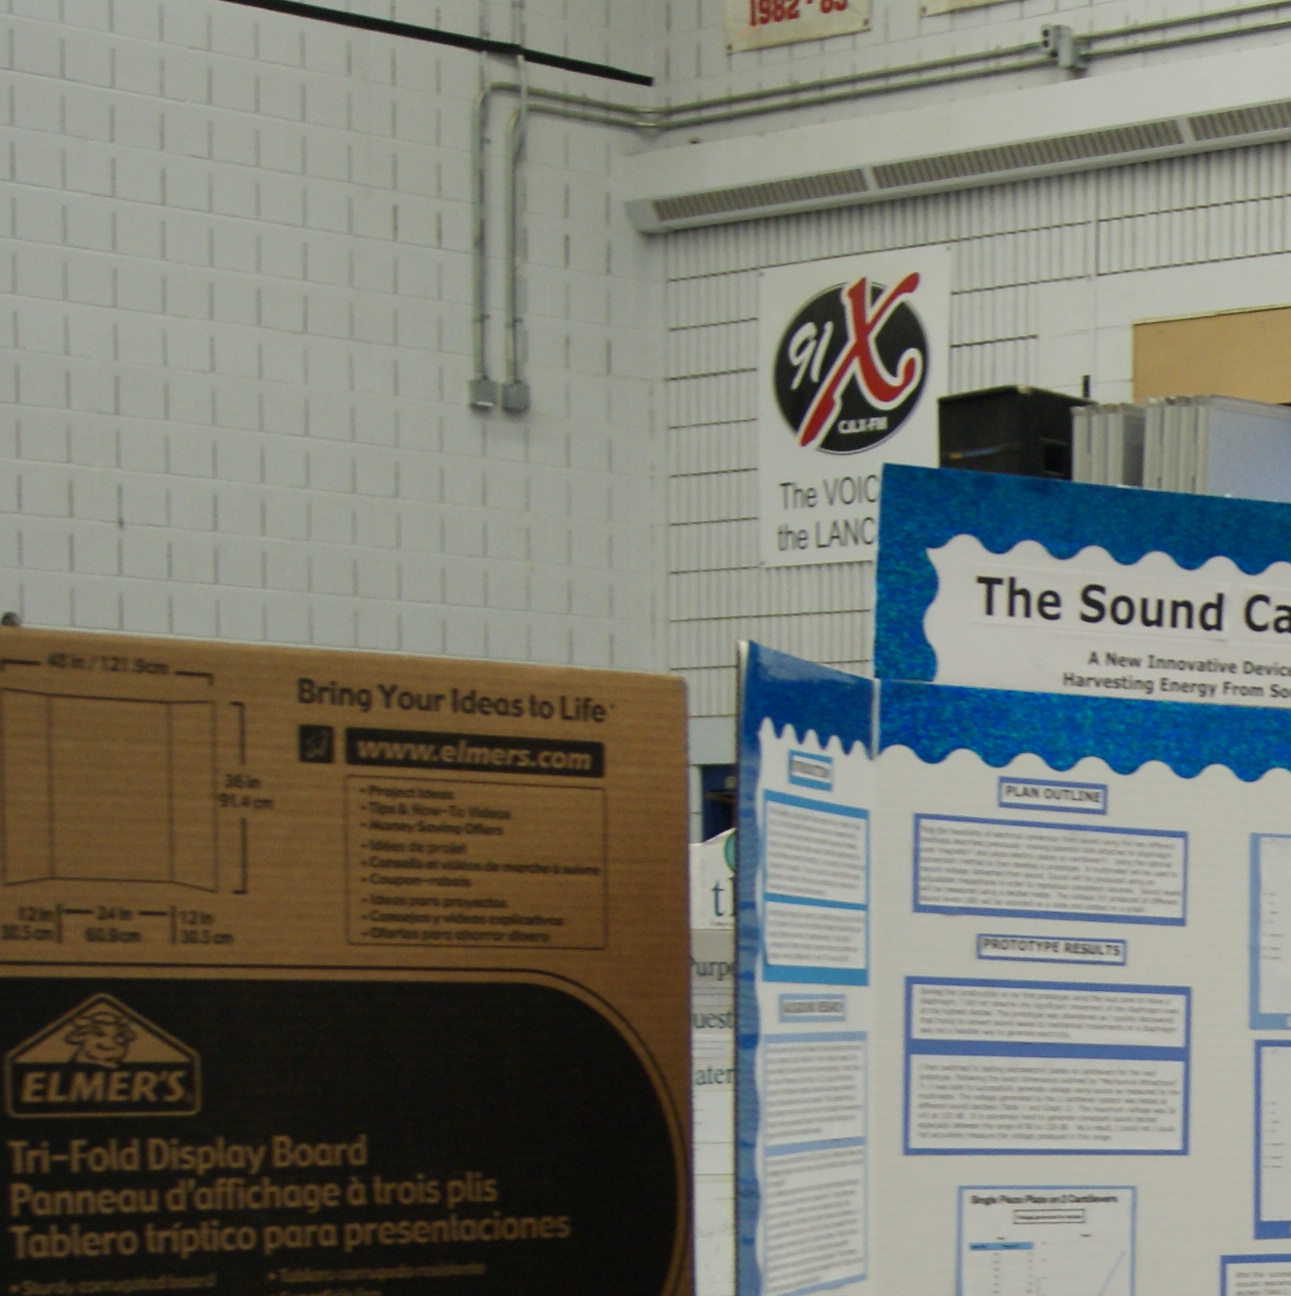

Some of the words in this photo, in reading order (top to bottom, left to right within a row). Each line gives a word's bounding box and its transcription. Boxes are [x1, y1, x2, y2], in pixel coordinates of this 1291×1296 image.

[779, 481, 818, 509] The
[823, 474, 880, 506] VOIC
[778, 525, 810, 552] the
[815, 516, 878, 549] LANC
[977, 574, 1063, 621] The
[1079, 583, 1224, 633] Sound
[1088, 650, 1099, 668] A
[1104, 653, 1143, 670] New
[1147, 654, 1237, 675] Innovative
[298, 677, 373, 713] Bring
[377, 683, 446, 711] Your
[449, 688, 525, 719] Ideas
[528, 694, 556, 721] to
[559, 696, 608, 723] Life
[1062, 670, 1155, 695] Harvesting
[1159, 675, 1217, 699] Energy
[1222, 680, 1264, 697] From
[356, 738, 591, 771] www.elmers.com
[1005, 784, 1041, 800] PLAN
[1043, 787, 1101, 805] OUTLINE
[982, 937, 1060, 957] PROTOTYPE
[1063, 942, 1121, 960] RESULTS
[22, 1070, 188, 1103] ELMER'S
[7, 1137, 140, 1175] Tri-Fold
[146, 1136, 266, 1177] Display
[271, 1133, 368, 1169] Board
[10, 1181, 159, 1217] Panneau
[164, 1174, 341, 1214] d'affichage
[347, 1176, 368, 1208] à
[371, 1172, 442, 1207] trois
[445, 1170, 499, 1210] plis
[11, 1223, 138, 1260] Tablero
[145, 1219, 257, 1260] tríptico
[263, 1221, 339, 1256] para
[342, 1210, 571, 1254] presentaciones
